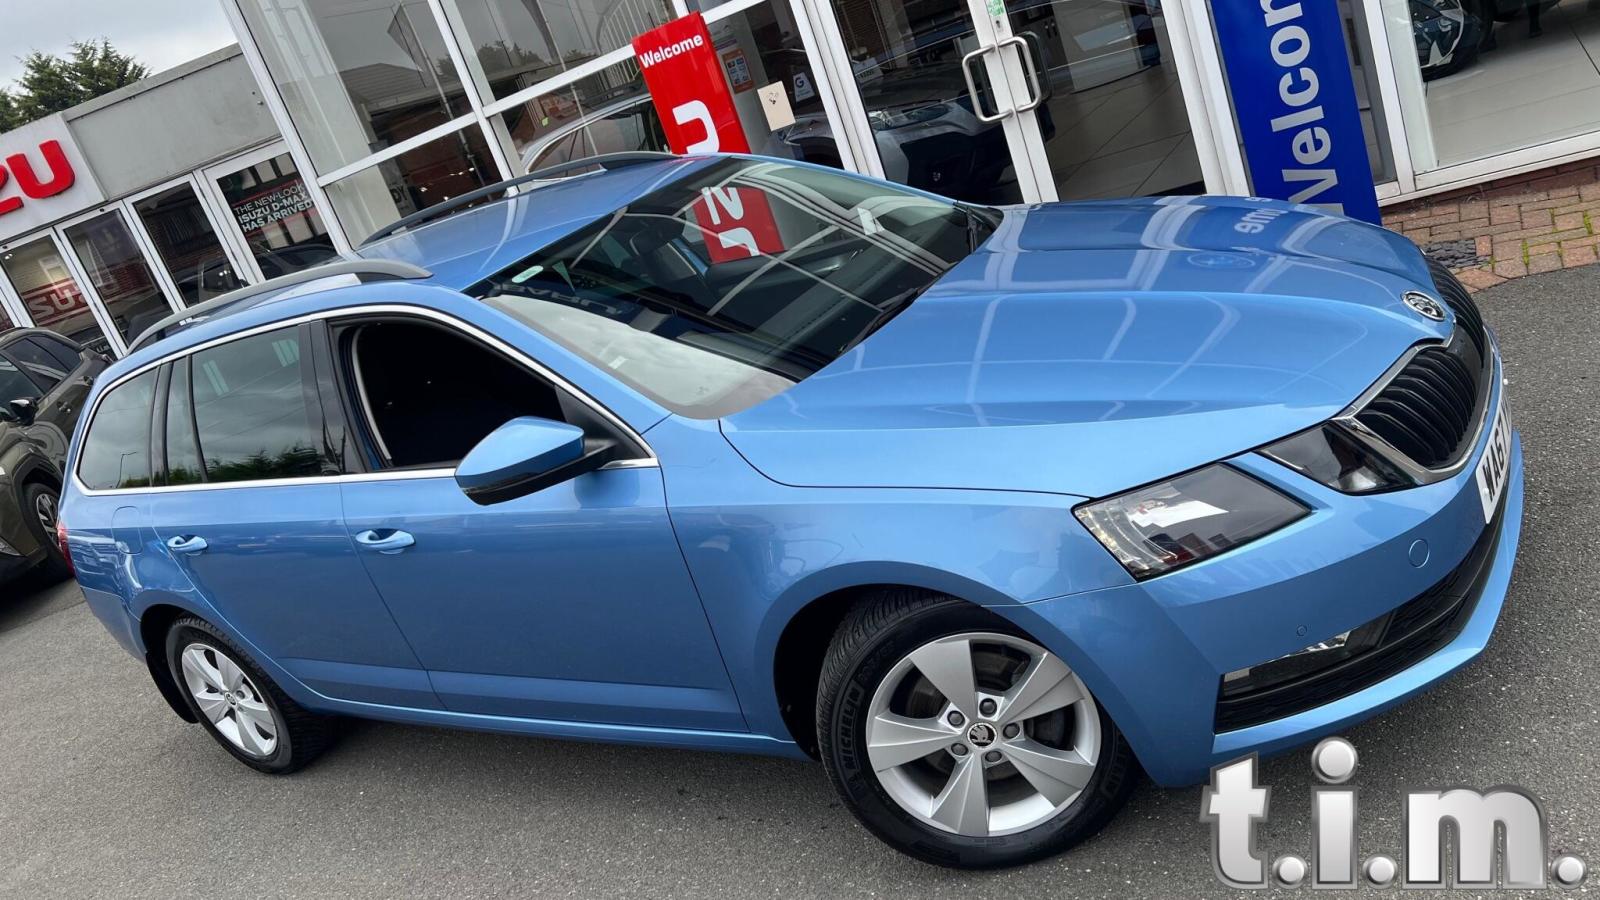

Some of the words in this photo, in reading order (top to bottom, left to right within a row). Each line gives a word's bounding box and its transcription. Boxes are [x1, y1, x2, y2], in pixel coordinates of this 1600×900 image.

[639, 34, 704, 69] Welcome
[1260, 0, 1344, 217] Welco
[233, 202, 255, 215] THE
[237, 206, 271, 224] ISUZU
[271, 192, 308, 211] D-MAX
[241, 217, 266, 232] HAS
[267, 199, 313, 222] ARRIVED
[25, 285, 86, 318] SU
[839, 686, 862, 771] MICHELIN
